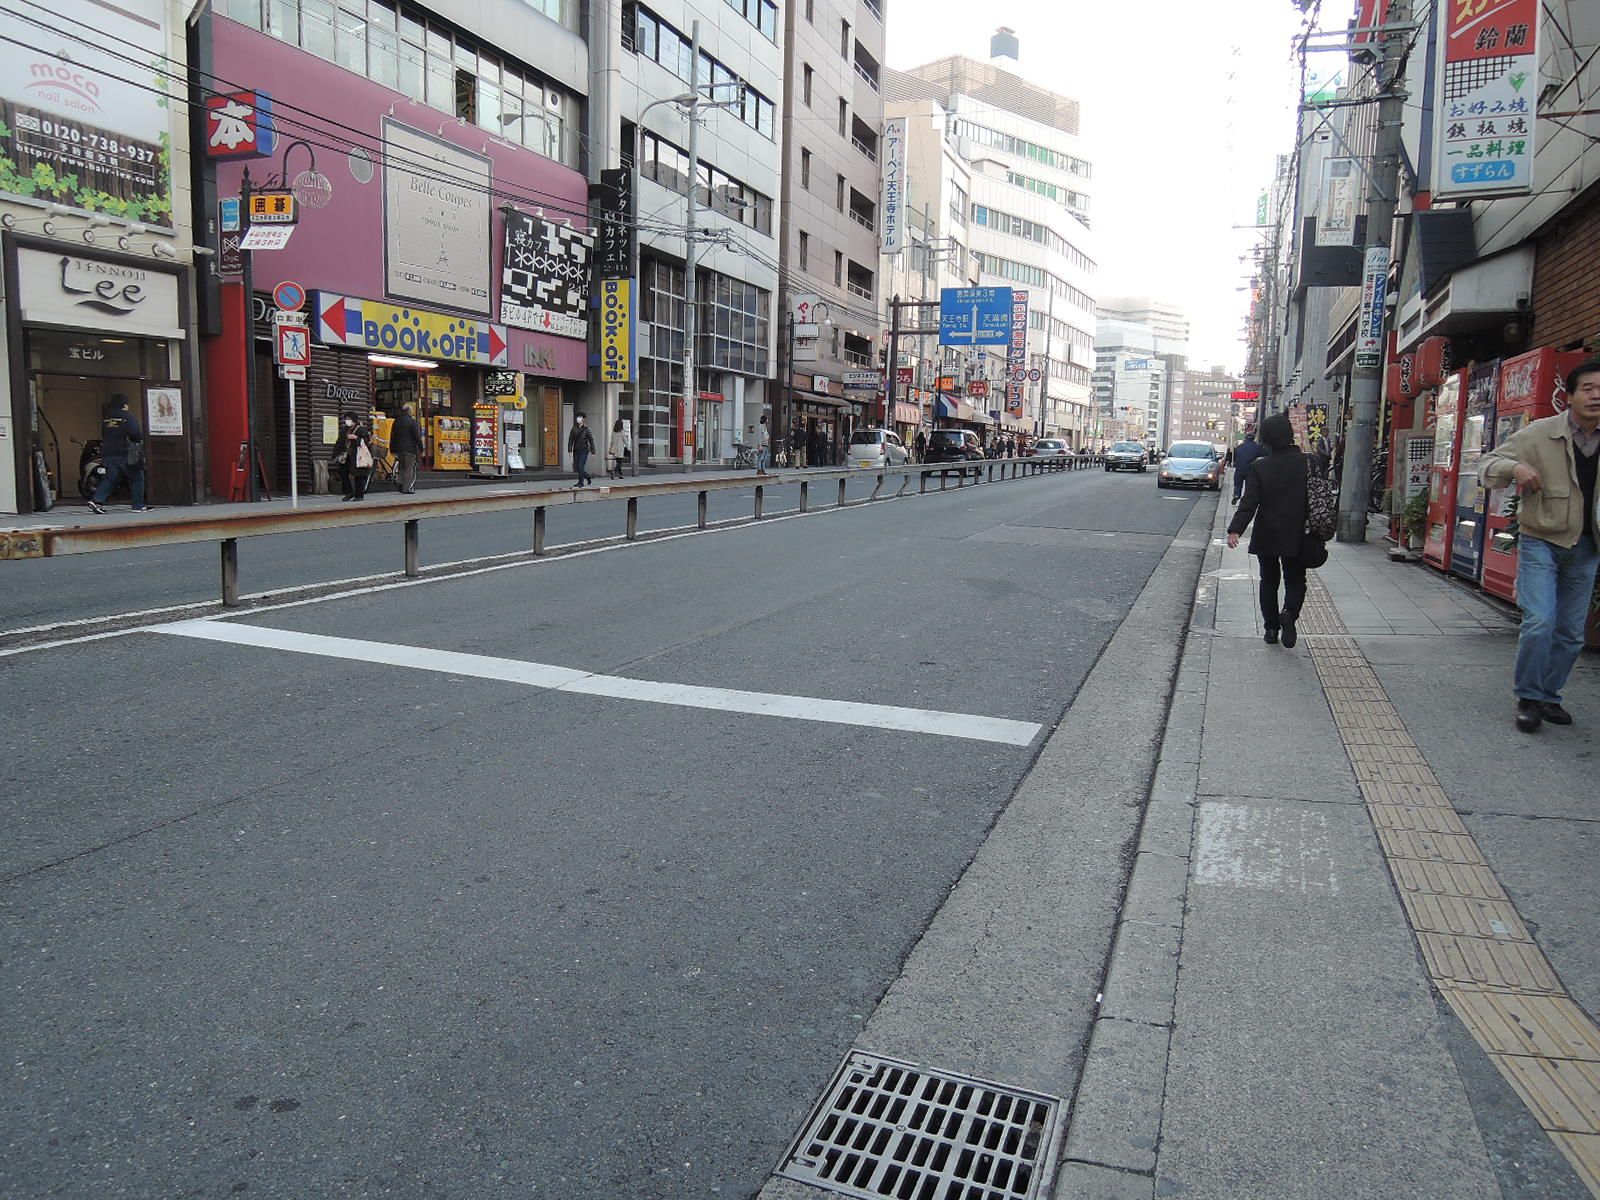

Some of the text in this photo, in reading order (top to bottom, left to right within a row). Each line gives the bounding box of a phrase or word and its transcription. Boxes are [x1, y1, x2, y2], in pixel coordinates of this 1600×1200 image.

[1475, 24, 1528, 50] 鈴蘭
[30, 63, 100, 98] moca
[38, 88, 96, 114] nail salon
[1450, 97, 1529, 118] お好み焼
[210, 100, 255, 149] 本
[1446, 117, 1529, 138] 鉄板焼
[42, 120, 154, 163] 0120-738-937
[1447, 140, 1526, 159] 一品料理
[1455, 164, 1512, 180] すずらん
[410, 176, 472, 209] Belle Coupes
[885, 137, 898, 246] アーベイ天王寺ホテル
[617, 172, 628, 263] インターネット
[60, 256, 146, 303] Lee
[326, 383, 361, 403] Dagaz
[475, 420, 494, 436] 本
